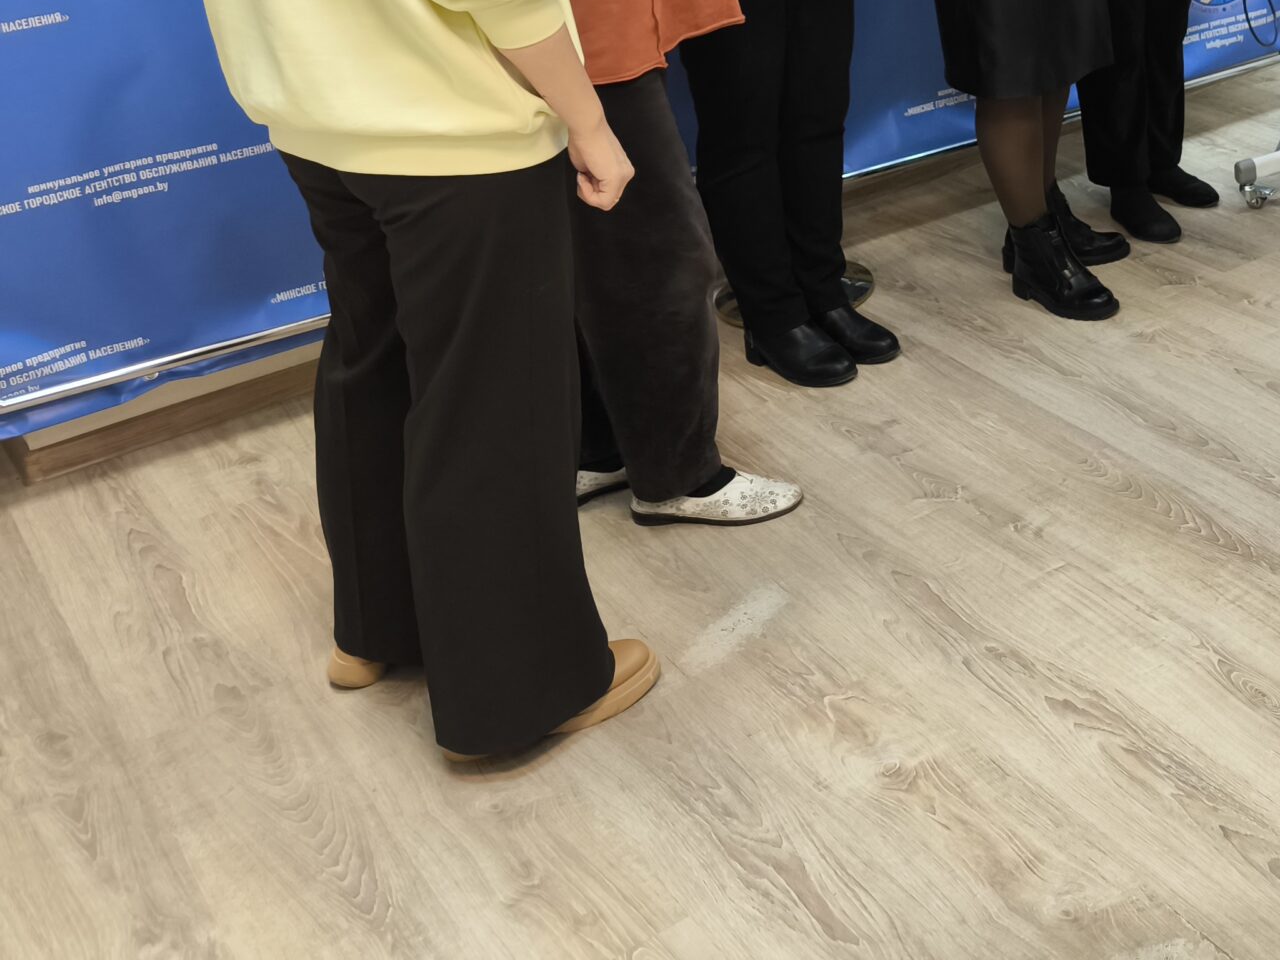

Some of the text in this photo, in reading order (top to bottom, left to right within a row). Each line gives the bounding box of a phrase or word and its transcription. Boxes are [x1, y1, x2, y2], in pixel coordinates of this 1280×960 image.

[0, 11, 70, 33] НАСЕЛЕНИЯ»
[24, 188, 83, 210] ГОРОДСКОЕ
[84, 172, 138, 196] АГЕНТСТВО
[139, 154, 219, 180] ОБСЛУЖИВАНИЯ
[27, 142, 219, 194] коммунальное унитарное предприятие
[94, 180, 169, 208] info@mgaon.by
[9, 335, 151, 386] ОБСЛУЖИВАНИЯ НАСЕЛЕНИЯ»
[25, 340, 87, 367] предприятие
